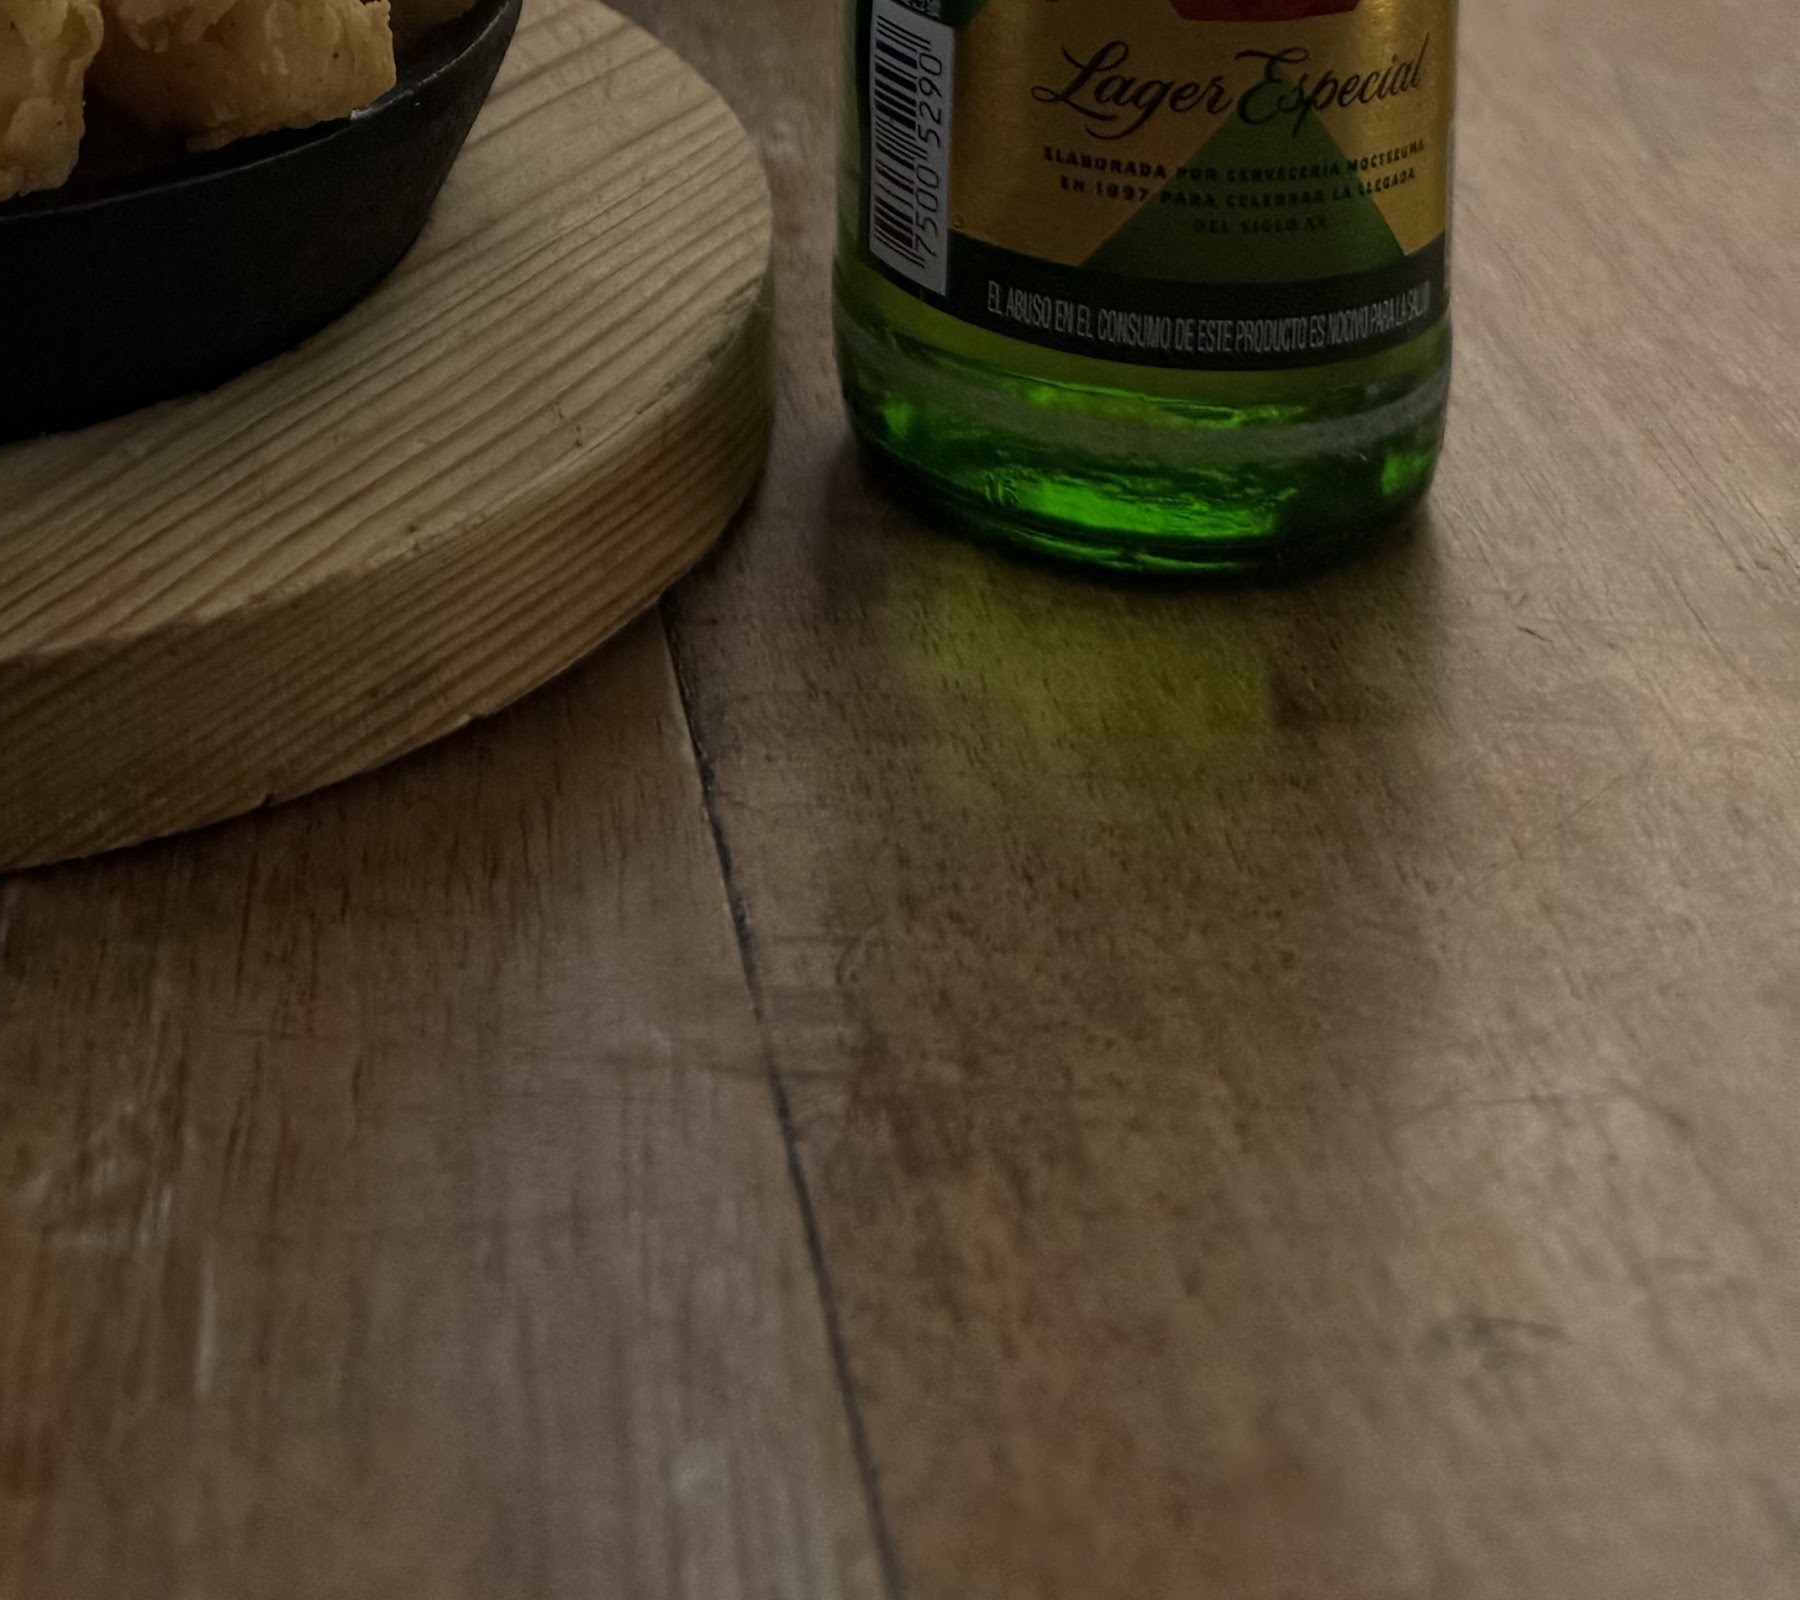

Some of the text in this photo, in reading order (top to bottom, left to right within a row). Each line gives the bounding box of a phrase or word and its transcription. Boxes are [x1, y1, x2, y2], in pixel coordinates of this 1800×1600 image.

[1030, 31, 1431, 141] Lager Especial
[914, 52, 943, 258] 7500 5290
[1043, 146, 1167, 180] ELABORADA
[1175, 166, 1217, 183] POR
[1058, 174, 1085, 194] EN
[1159, 189, 1218, 209] PARA
[1332, 185, 1351, 202] LA
[1358, 167, 1415, 197] LLEGADA
[1239, 217, 1298, 234] SIGLO
[987, 279, 1005, 315] EL
[1005, 287, 1053, 332] ABUSO
[1054, 298, 1075, 336] EN
[1076, 302, 1094, 339] EL
[1097, 310, 1172, 351] CONSUMO
[1174, 316, 1195, 352] DE
[1196, 318, 1234, 354] ESTE
[1235, 316, 1307, 354] PRODUCTO
[1309, 314, 1326, 349] ES
[1327, 301, 1370, 346] NOCIVO
[1370, 293, 1396, 337] PARA
